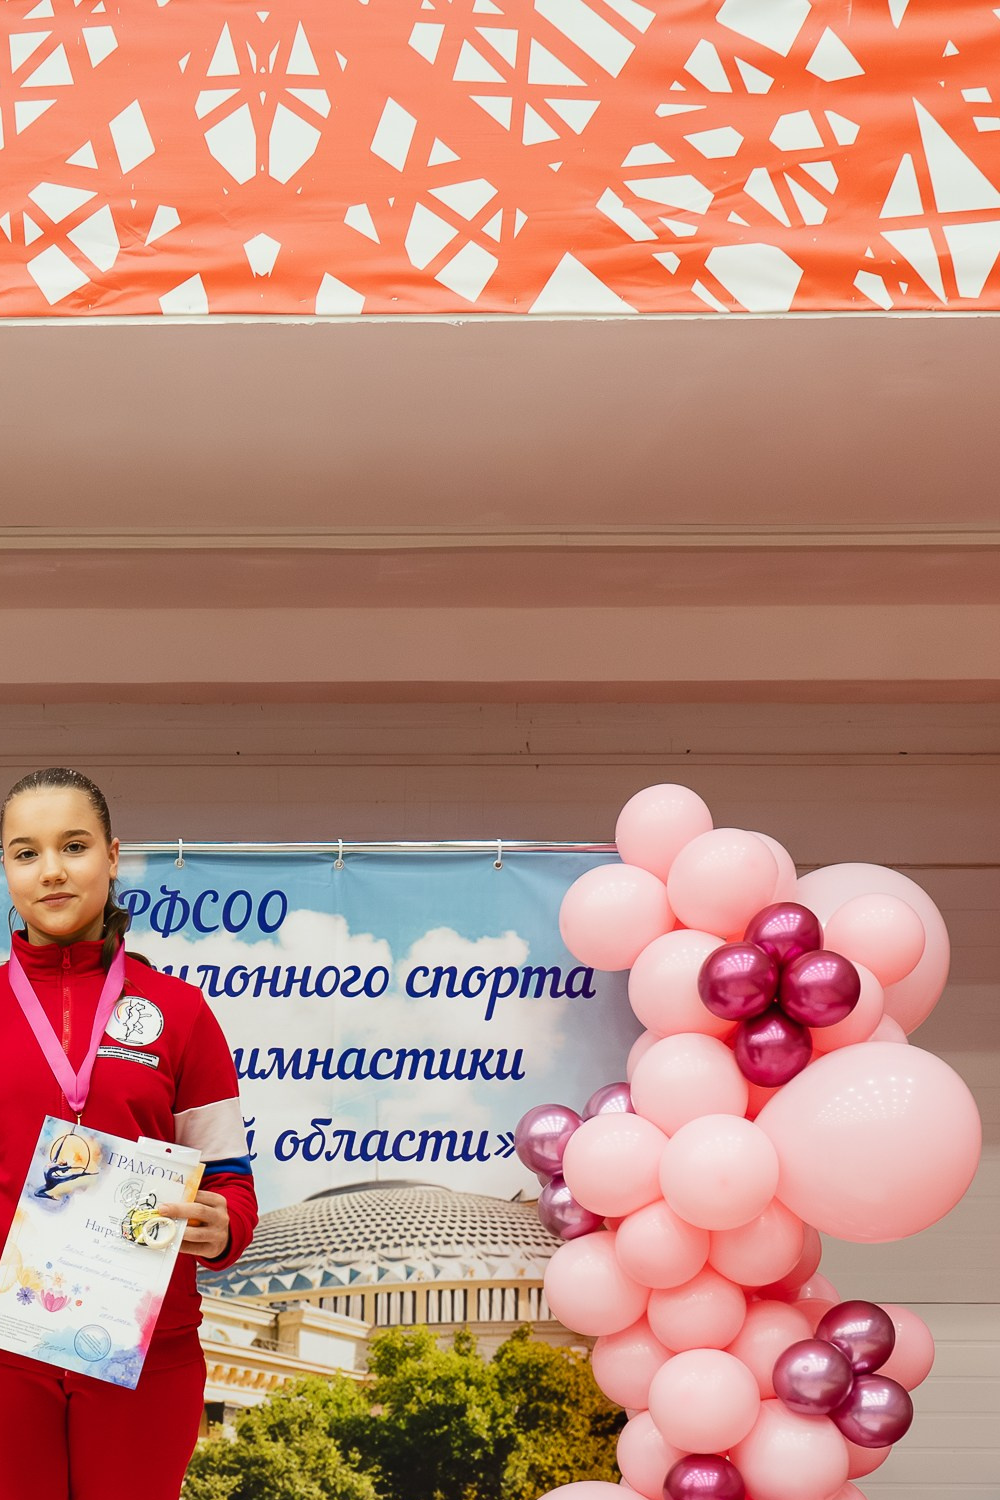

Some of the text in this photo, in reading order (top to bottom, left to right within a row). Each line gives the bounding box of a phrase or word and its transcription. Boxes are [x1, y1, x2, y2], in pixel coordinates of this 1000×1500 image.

[118, 885, 288, 938] РФСОО
[405, 964, 597, 1021] спорта
[274, 1117, 515, 1162] области»
